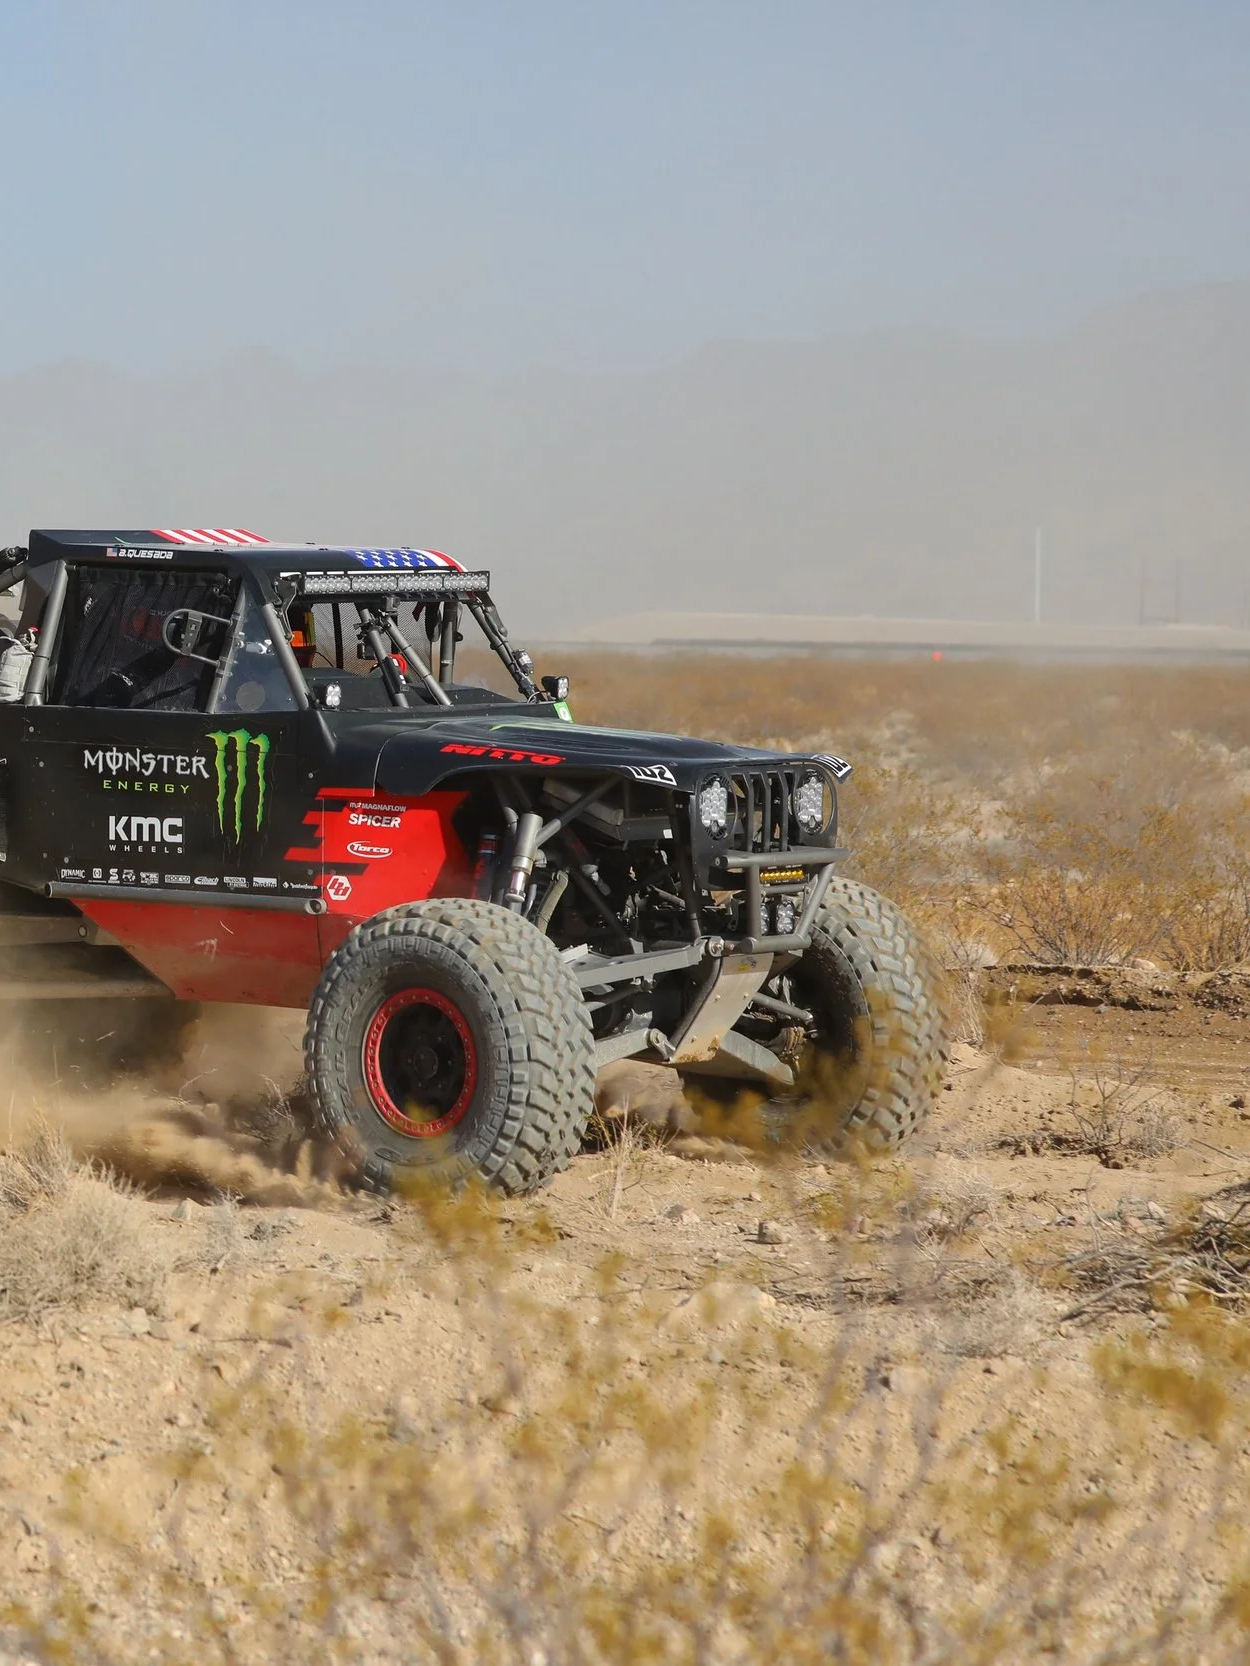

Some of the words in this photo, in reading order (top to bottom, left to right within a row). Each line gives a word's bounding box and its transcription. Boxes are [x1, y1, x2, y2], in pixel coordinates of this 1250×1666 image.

[440, 743, 562, 765] NITTO
[83, 747, 210, 779] MONSTER
[103, 780, 190, 794] ENERGY
[362, 803, 406, 812] MAGNAFLOW
[349, 813, 401, 828] SPICER
[108, 815, 183, 843] KMC
[109, 845, 183, 854] WHEELS
[353, 843, 390, 853] Torco
[61, 868, 85, 879] DYNAMIC
